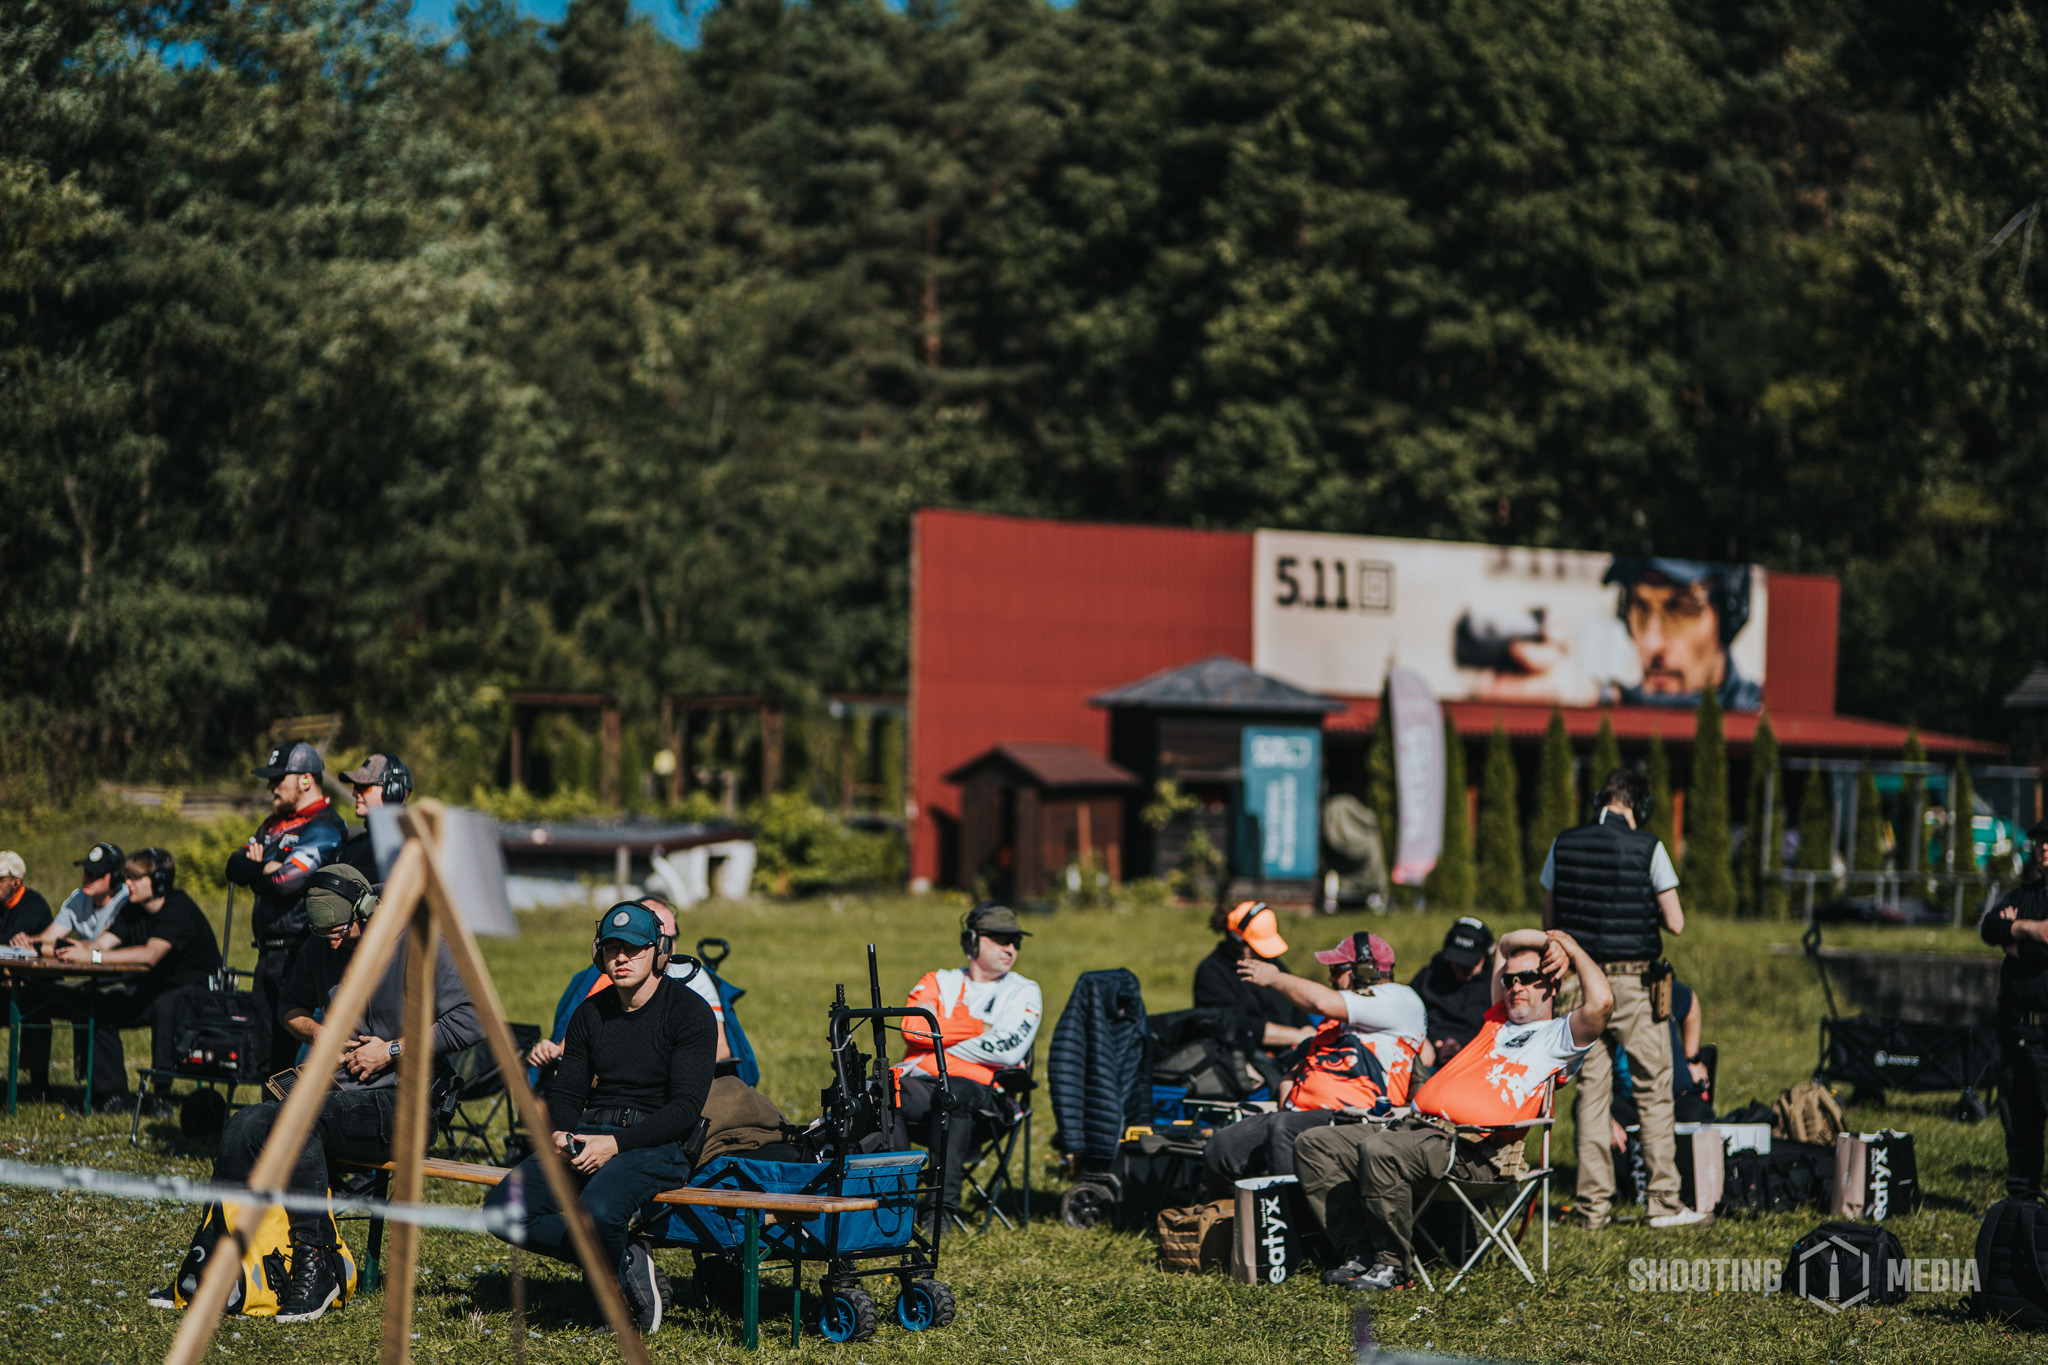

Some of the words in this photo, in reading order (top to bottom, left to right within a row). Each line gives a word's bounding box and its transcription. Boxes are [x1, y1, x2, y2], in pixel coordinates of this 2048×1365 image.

[1276, 556, 1349, 609] 5.11
[1870, 1146, 1892, 1221] eatyx
[1262, 1195, 1288, 1284] eatyx
